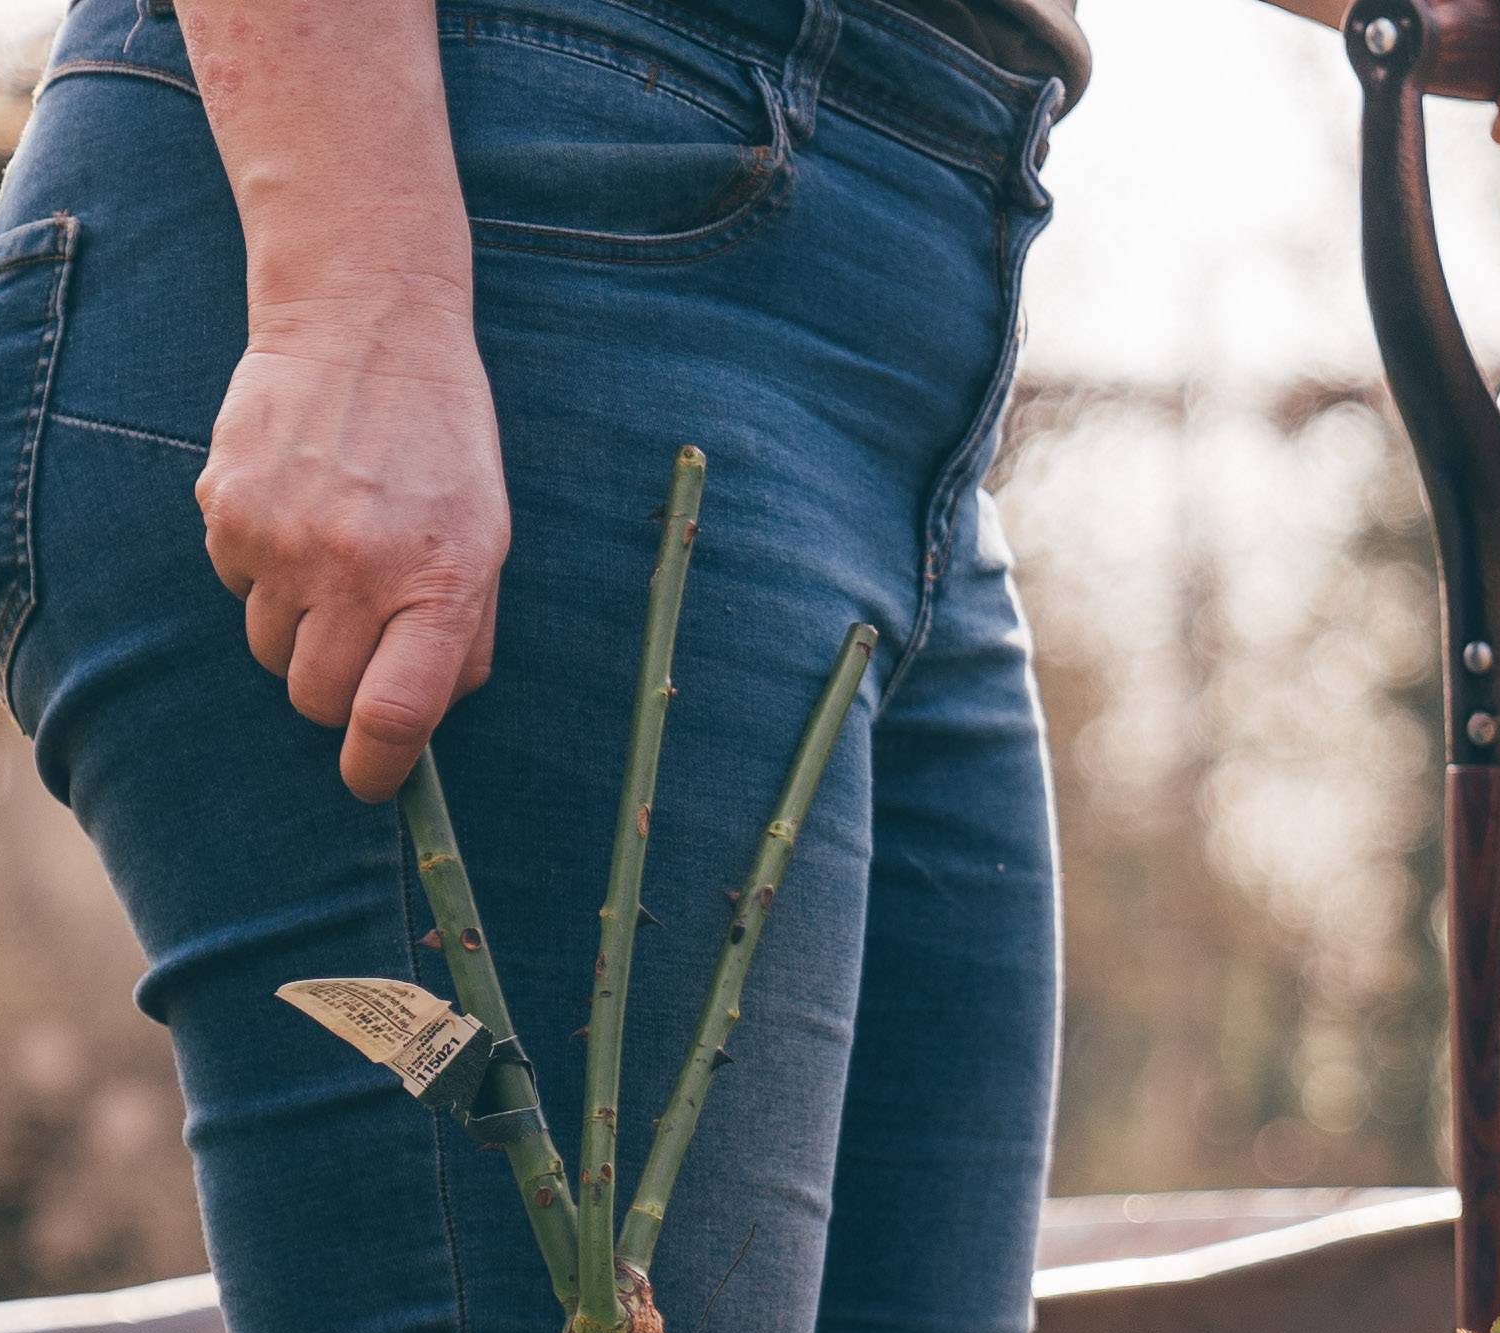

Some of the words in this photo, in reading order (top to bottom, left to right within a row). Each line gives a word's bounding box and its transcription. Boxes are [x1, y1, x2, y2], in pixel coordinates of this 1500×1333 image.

[416, 1019, 449, 1051] PASSPORT
[418, 1022, 439, 1041] PLANT
[415, 1037, 460, 1081] 115021
